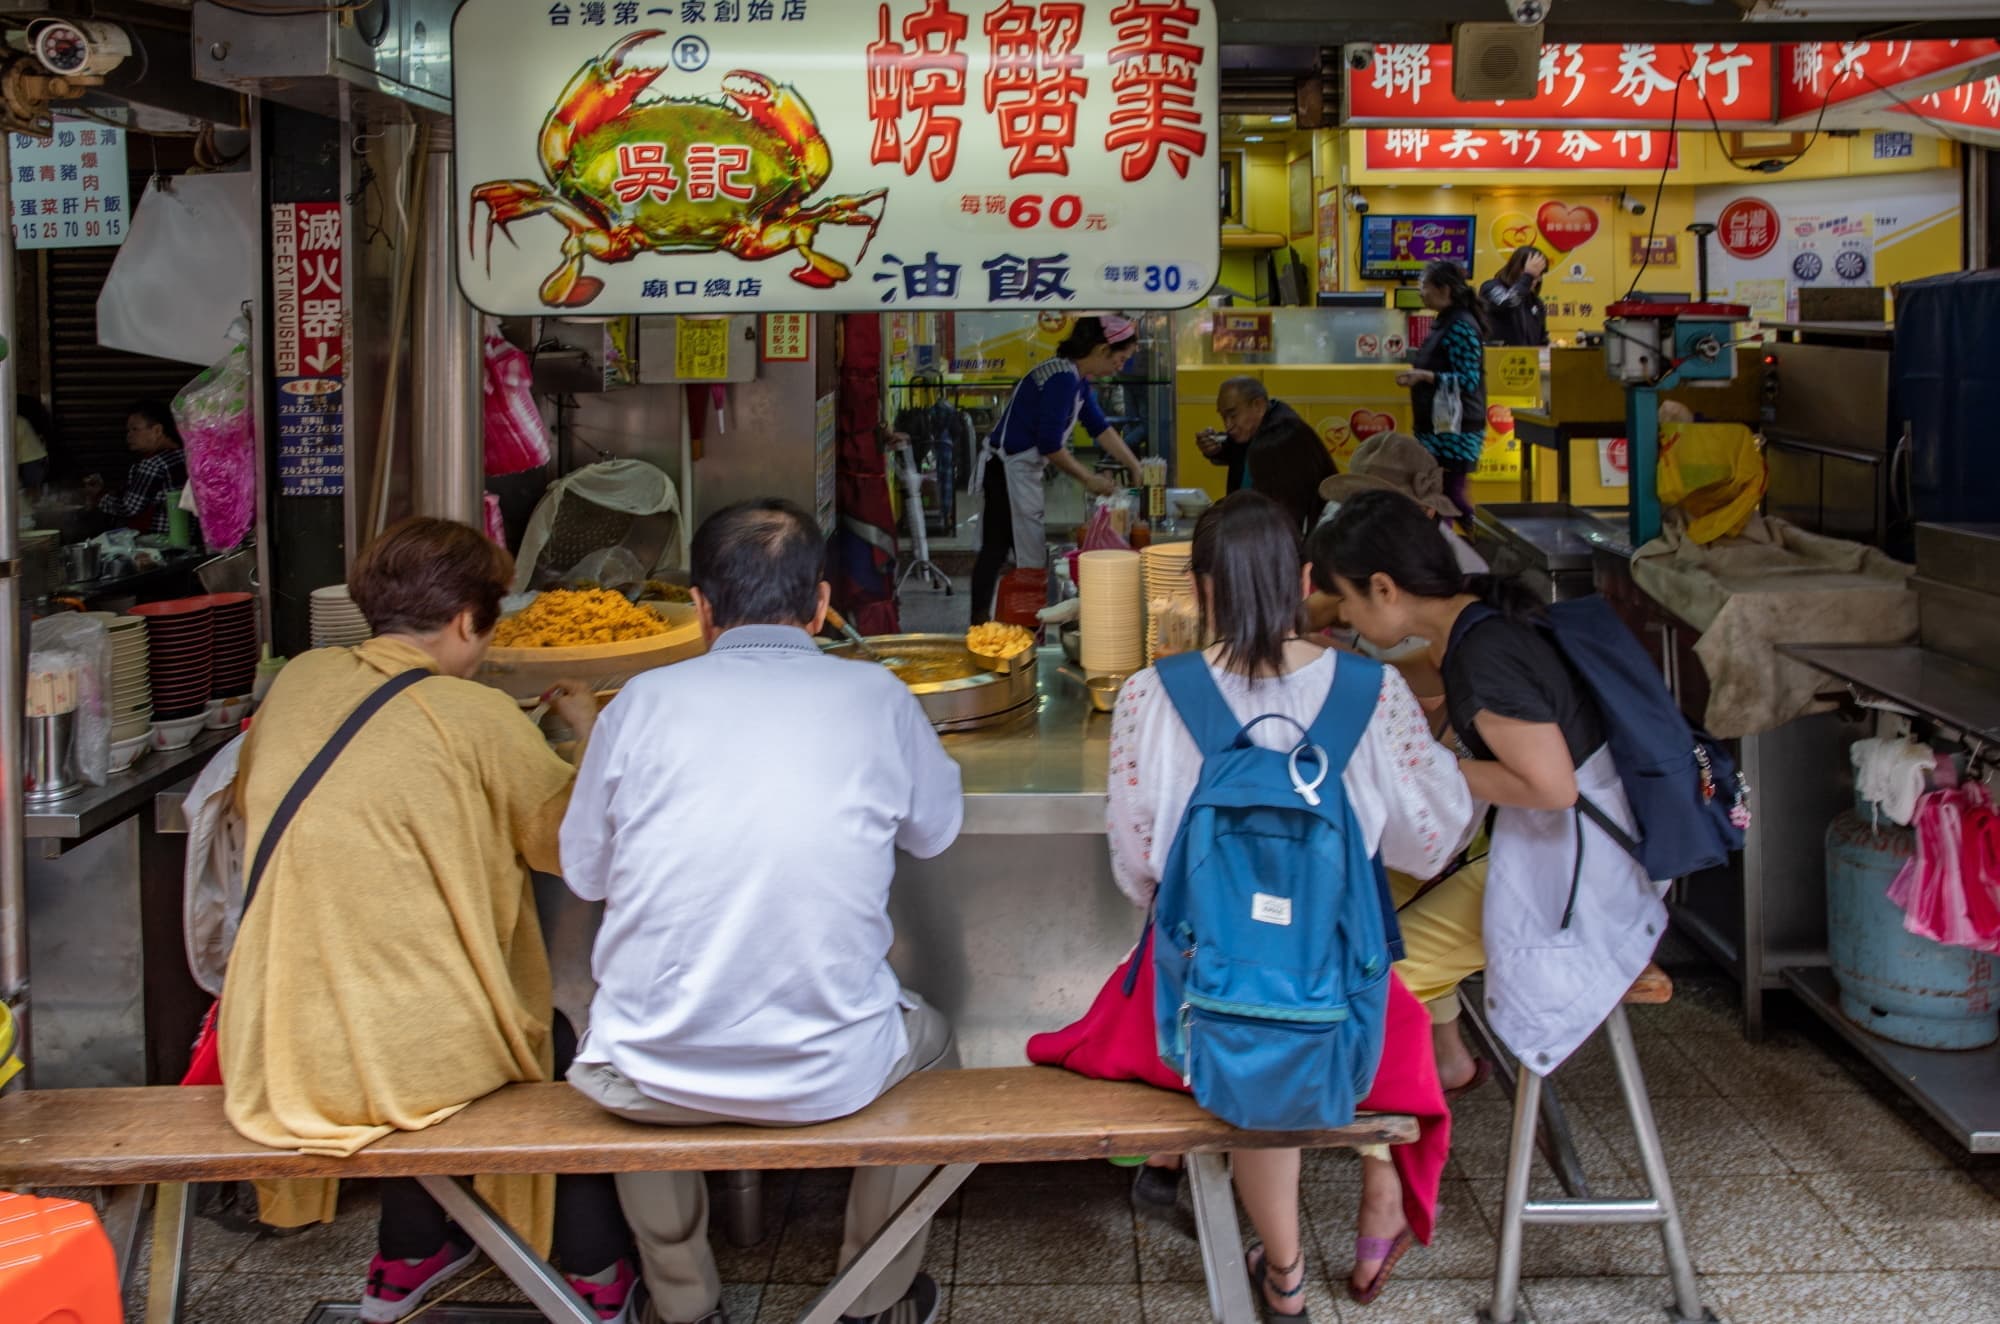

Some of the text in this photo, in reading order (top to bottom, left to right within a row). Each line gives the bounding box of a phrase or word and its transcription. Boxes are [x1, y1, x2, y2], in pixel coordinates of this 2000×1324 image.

[1371, 43, 1753, 108] 聯彩券行
[613, 143, 755, 203] 吳記
[23, 224, 37, 240] 15
[43, 222, 58, 239] 25
[64, 221, 79, 238] 70
[86, 221, 100, 237] 90
[106, 219, 120, 236] 15
[1424, 240, 1452, 255] 2.8
[299, 209, 342, 338] 滅火器
[872, 251, 1076, 303] 油飯
[275, 208, 296, 373] FIRE-EXTINGUISHER
[641, 277, 763, 298] 廟口總店
